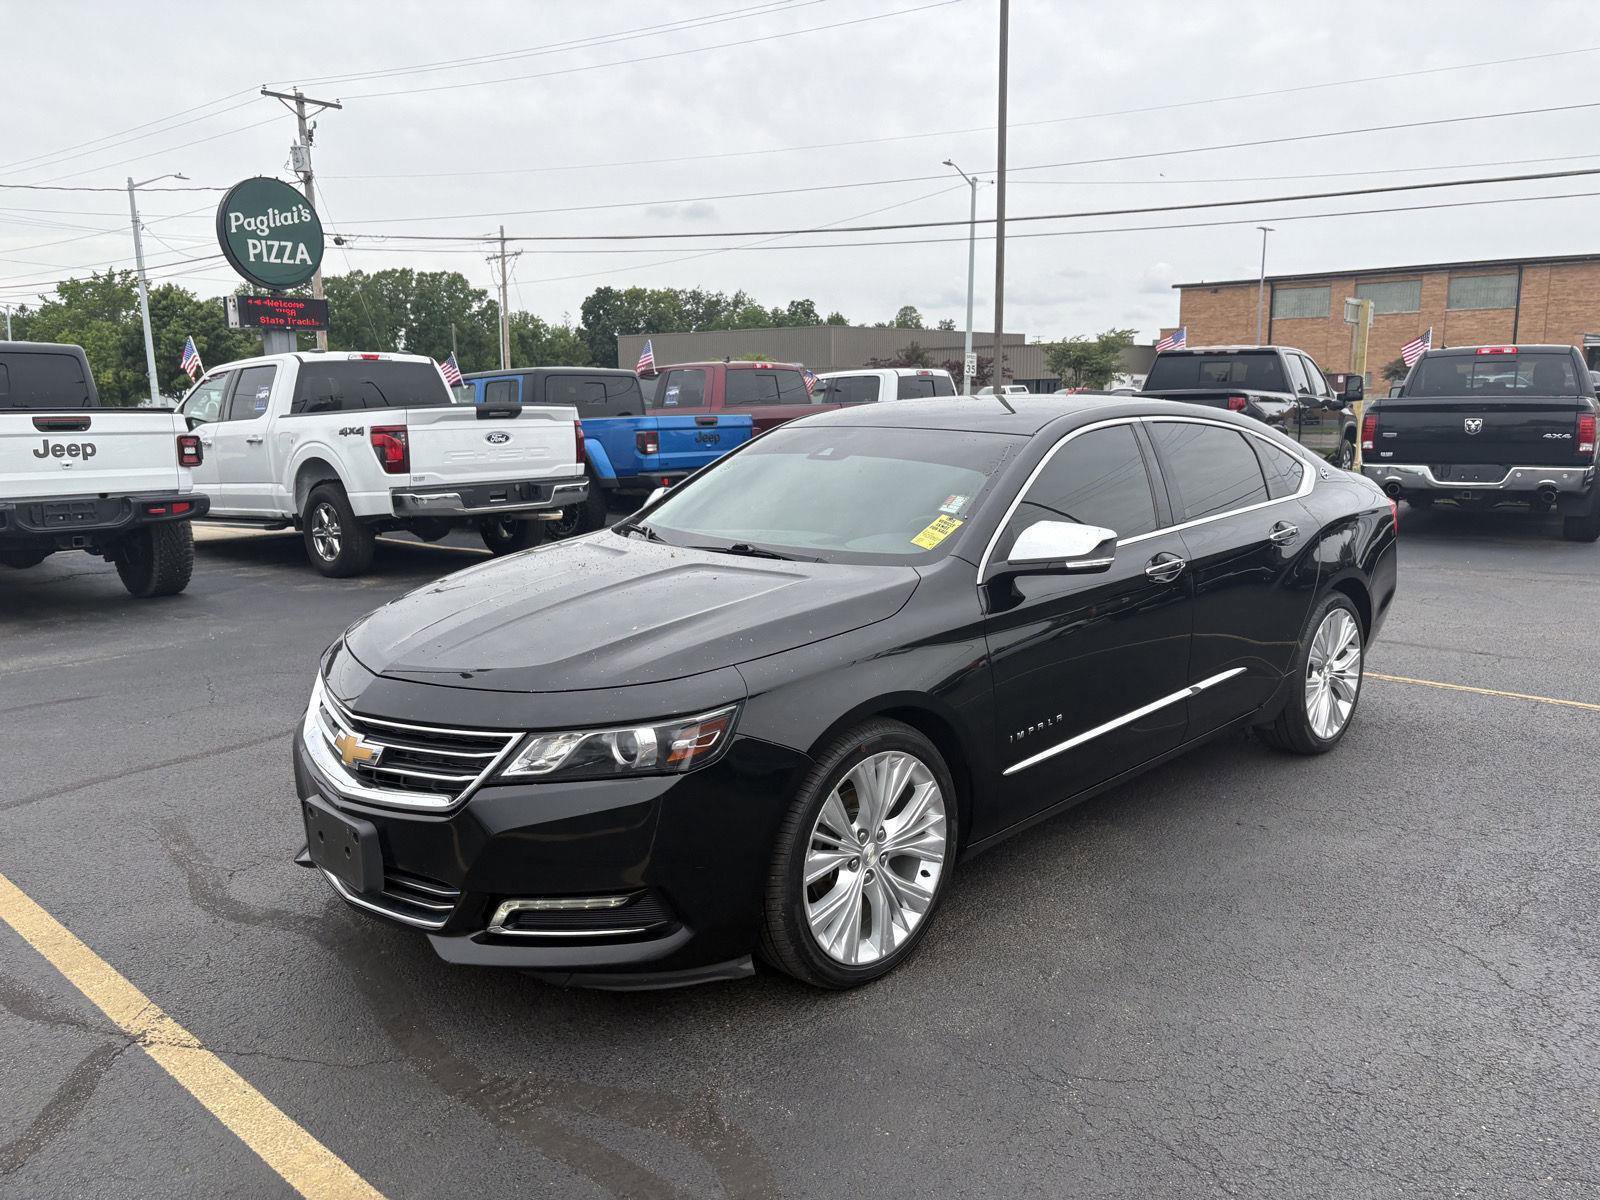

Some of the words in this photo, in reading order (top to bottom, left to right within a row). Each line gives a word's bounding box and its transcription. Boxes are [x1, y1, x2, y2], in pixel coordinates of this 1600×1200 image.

[229, 204, 311, 236] Pagliai's
[247, 239, 313, 265] PIZZA
[260, 316, 285, 325] State
[965, 364, 976, 373] 35
[694, 432, 720, 445] Jeep
[32, 439, 97, 460] Jeep
[1008, 713, 1063, 744] IMPALA
